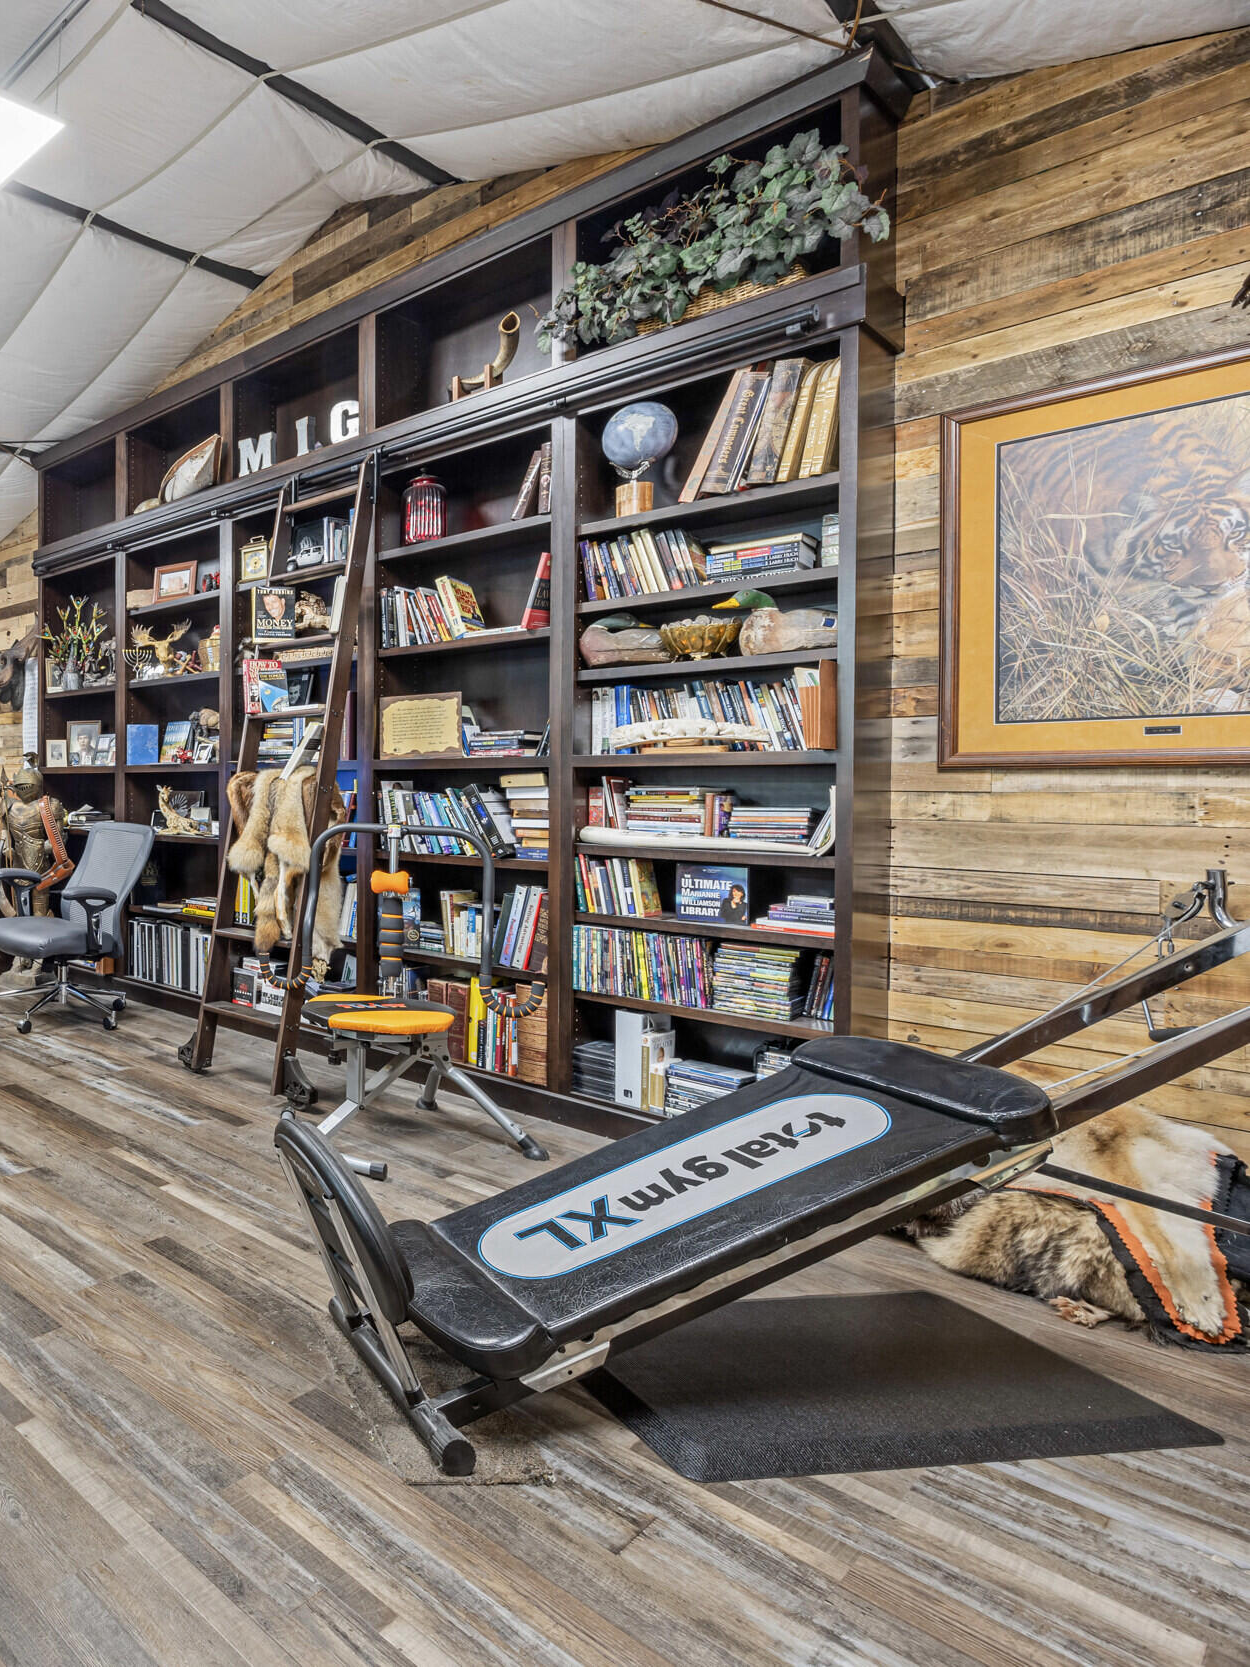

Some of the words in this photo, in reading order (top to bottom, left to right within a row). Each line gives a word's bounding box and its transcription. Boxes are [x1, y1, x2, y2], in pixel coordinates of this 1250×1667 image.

[737, 389, 755, 414] Great
[718, 416, 745, 464] Composers
[256, 618, 293, 627] MONEY
[250, 660, 267, 669] HOW
[269, 661, 279, 669] TO
[681, 878, 733, 890] ULTIMATE
[680, 906, 720, 917] LIBRARY
[681, 897, 721, 908] WILLIAMSON
[722, 1111, 847, 1170] total
[618, 1154, 729, 1212] gym
[513, 1194, 642, 1251] XL
